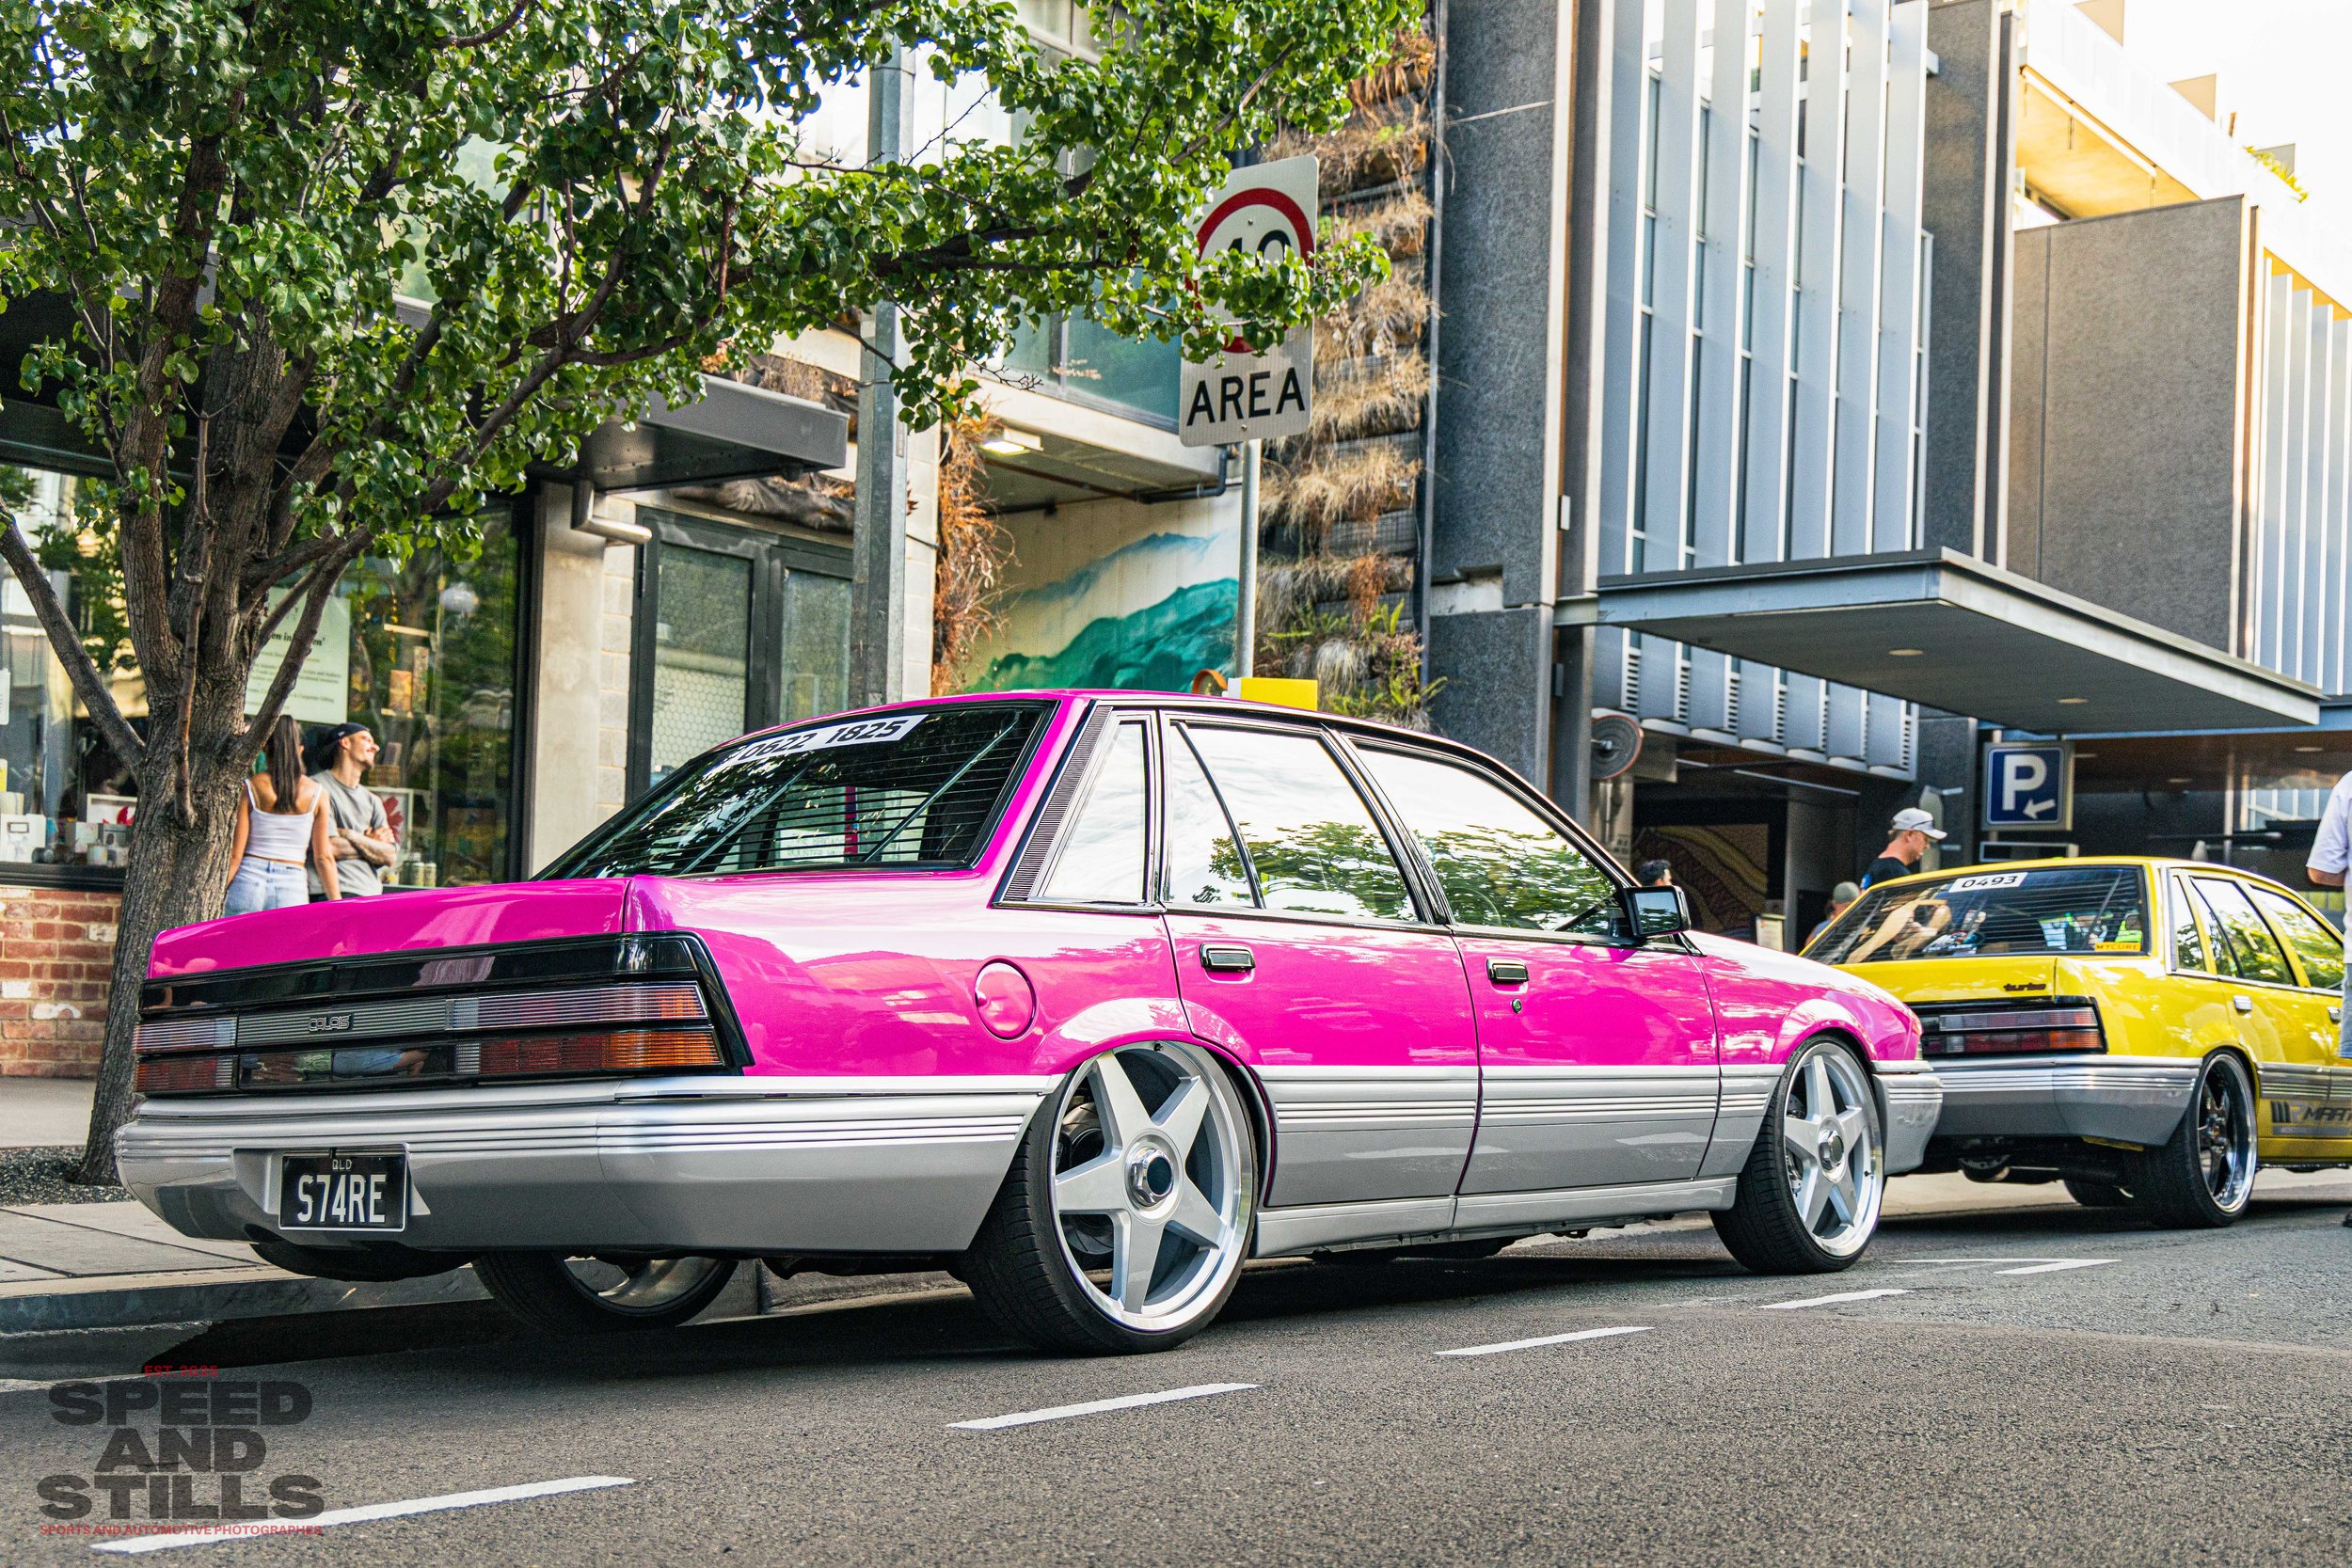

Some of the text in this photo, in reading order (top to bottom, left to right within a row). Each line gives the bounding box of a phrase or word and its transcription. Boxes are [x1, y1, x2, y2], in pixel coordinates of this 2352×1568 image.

[1186, 367, 1306, 426] AREA
[738, 720, 912, 761] 0622 1825
[2002, 754, 2047, 811] P
[1962, 876, 2018, 888] 0493
[2003, 982, 2046, 991] turbo
[332, 1159, 353, 1170] QLD
[297, 1174, 388, 1223] S74RE
